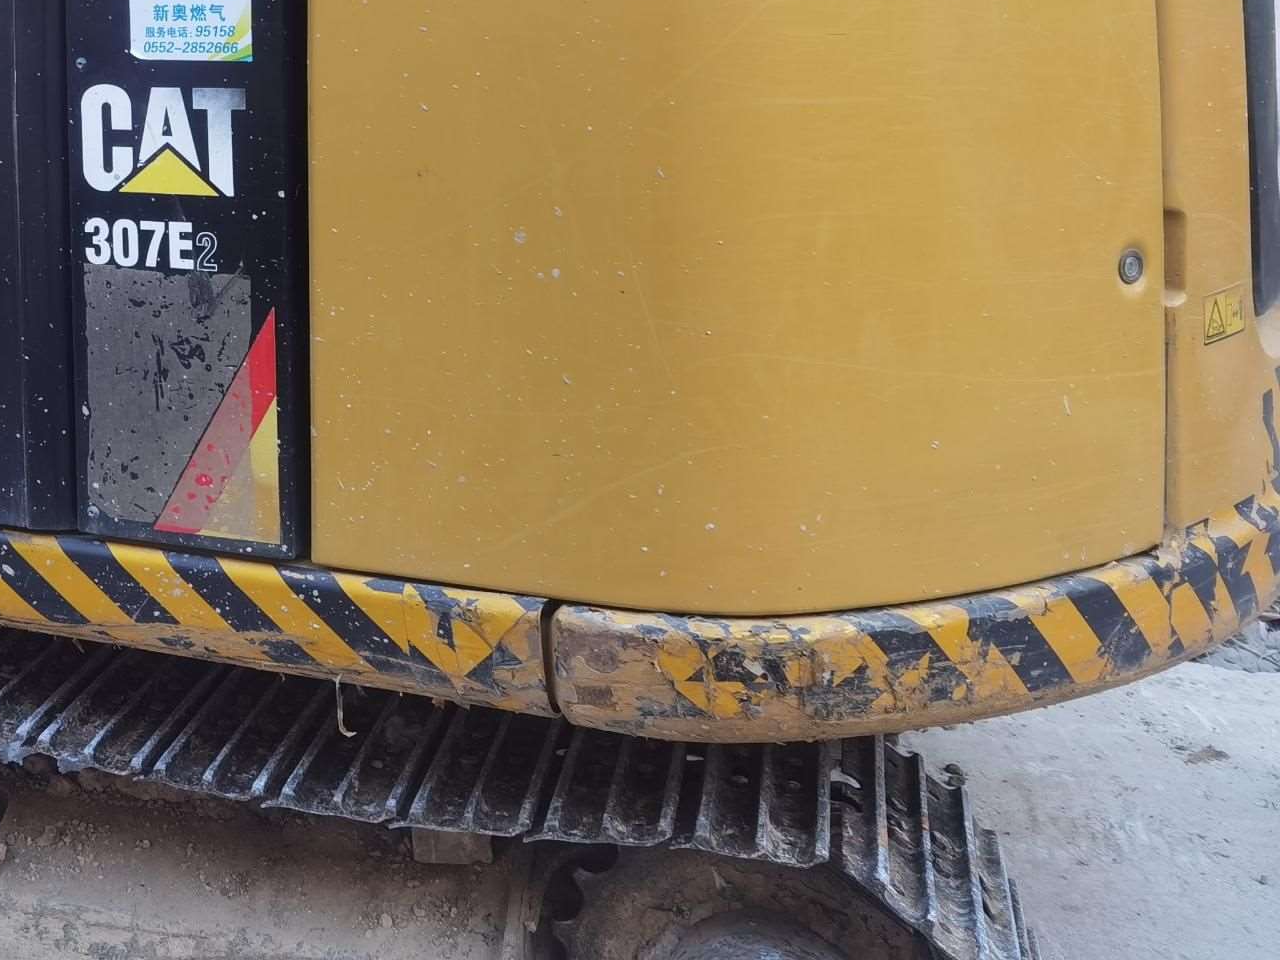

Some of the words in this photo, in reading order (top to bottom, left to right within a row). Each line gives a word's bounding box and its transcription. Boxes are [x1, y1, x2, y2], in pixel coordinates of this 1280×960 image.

[153, 4, 226, 22] 新奥燃气
[143, 41, 238, 54] 0552-2852666
[81, 83, 246, 197] CAT
